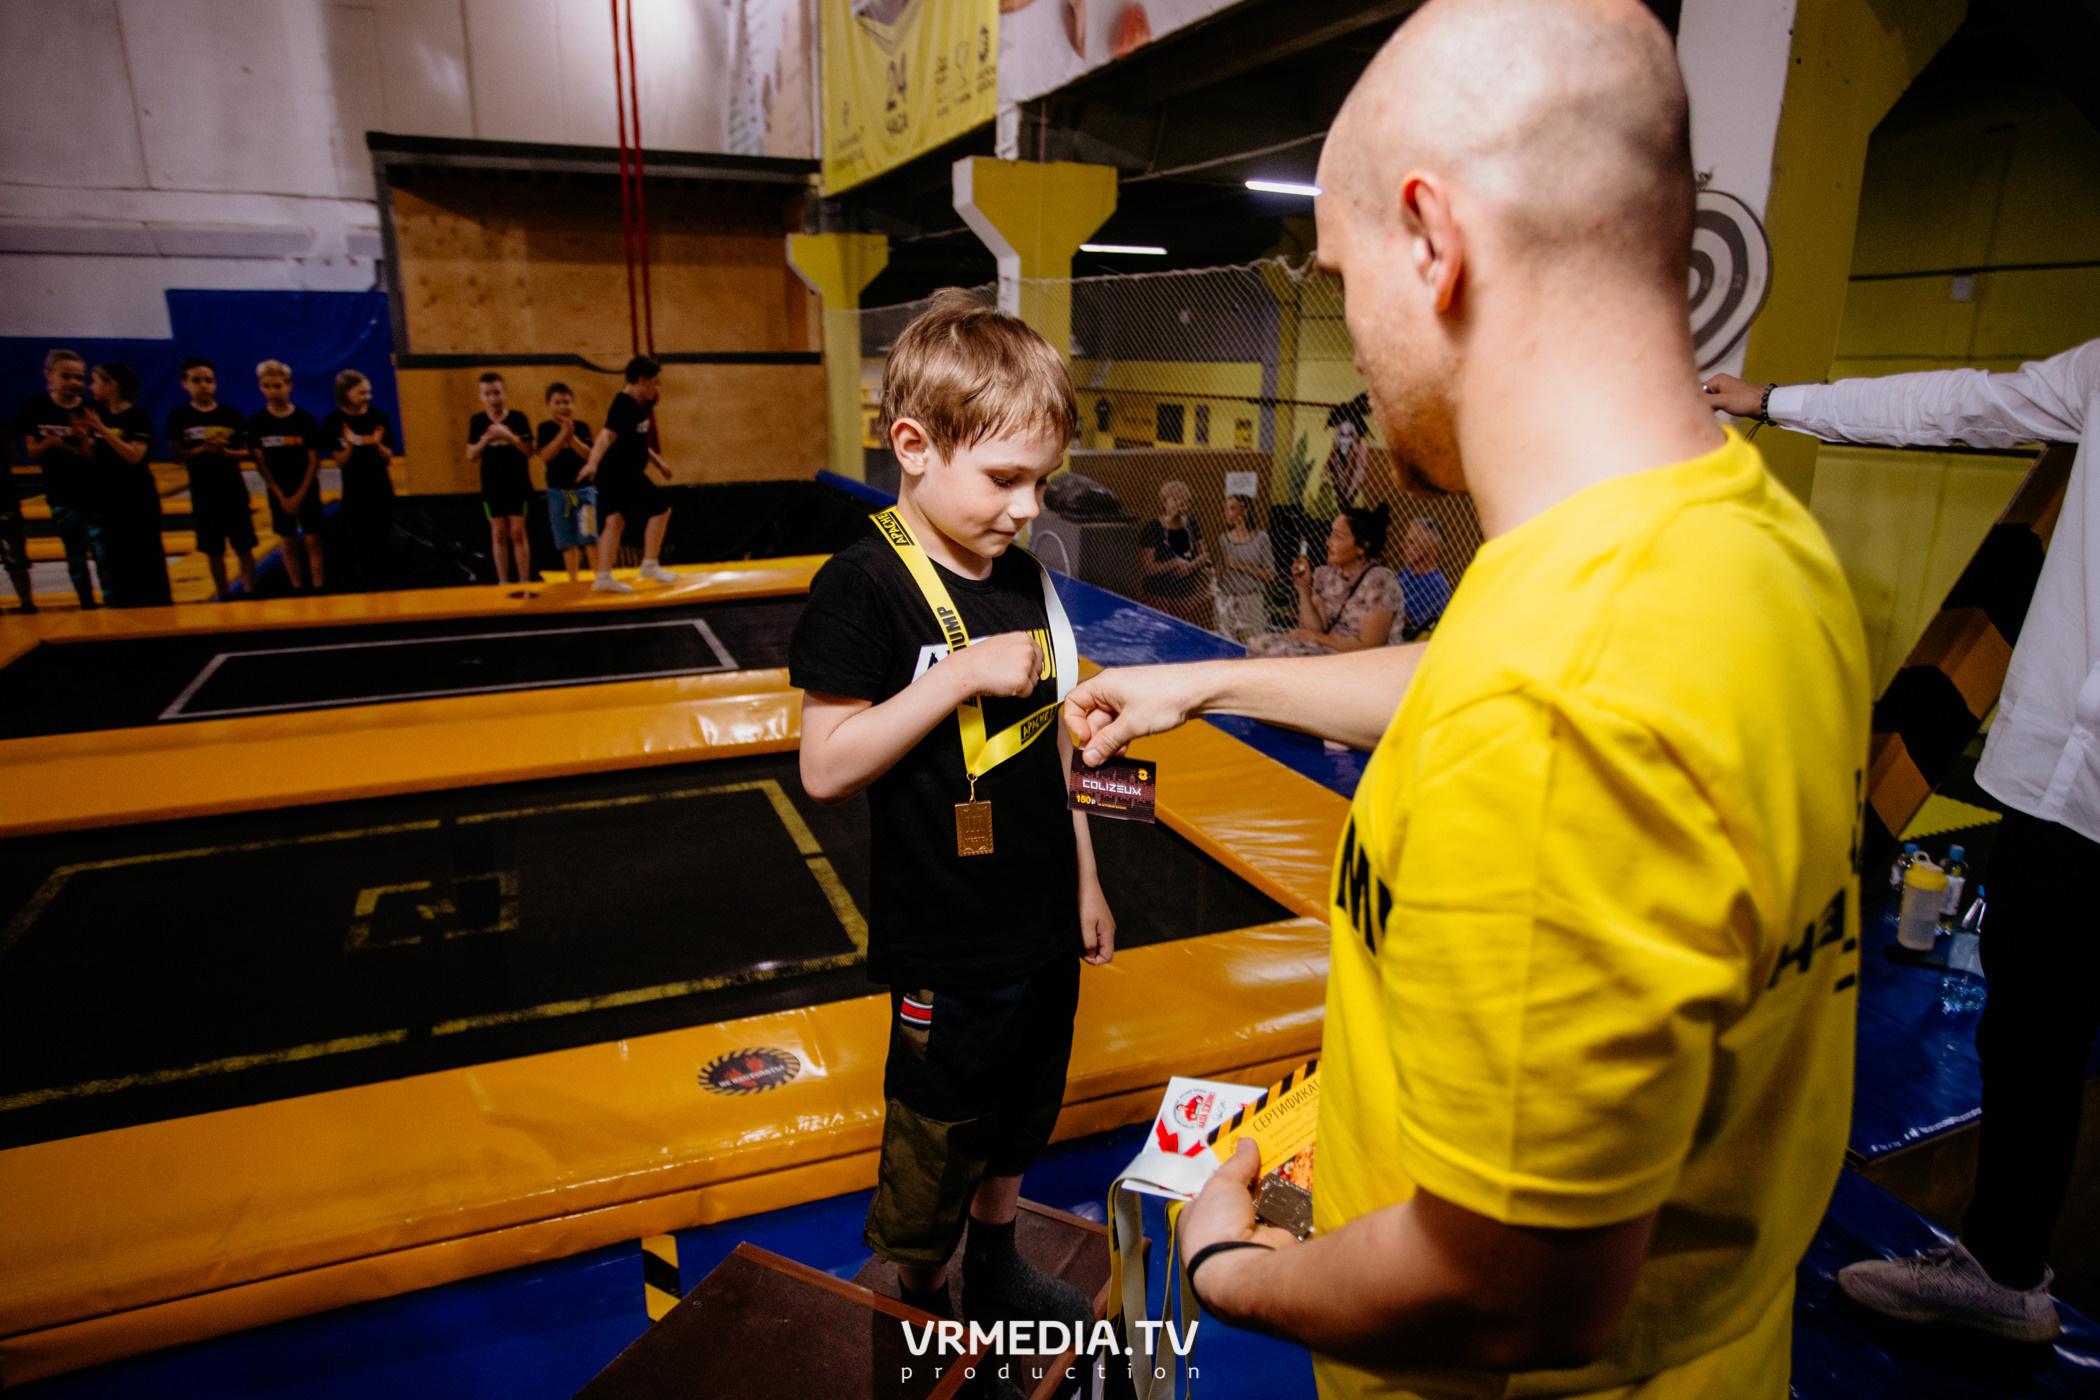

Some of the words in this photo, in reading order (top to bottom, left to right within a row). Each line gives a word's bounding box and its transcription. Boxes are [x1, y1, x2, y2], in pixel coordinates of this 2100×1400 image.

[875, 511, 910, 546] APACHE
[1022, 709, 1050, 738] APACHE
[1076, 794, 1091, 805] 150
[1082, 778, 1142, 796] COLIZEUM
[1252, 1079, 1320, 1133] СЕРТИФИКАТ
